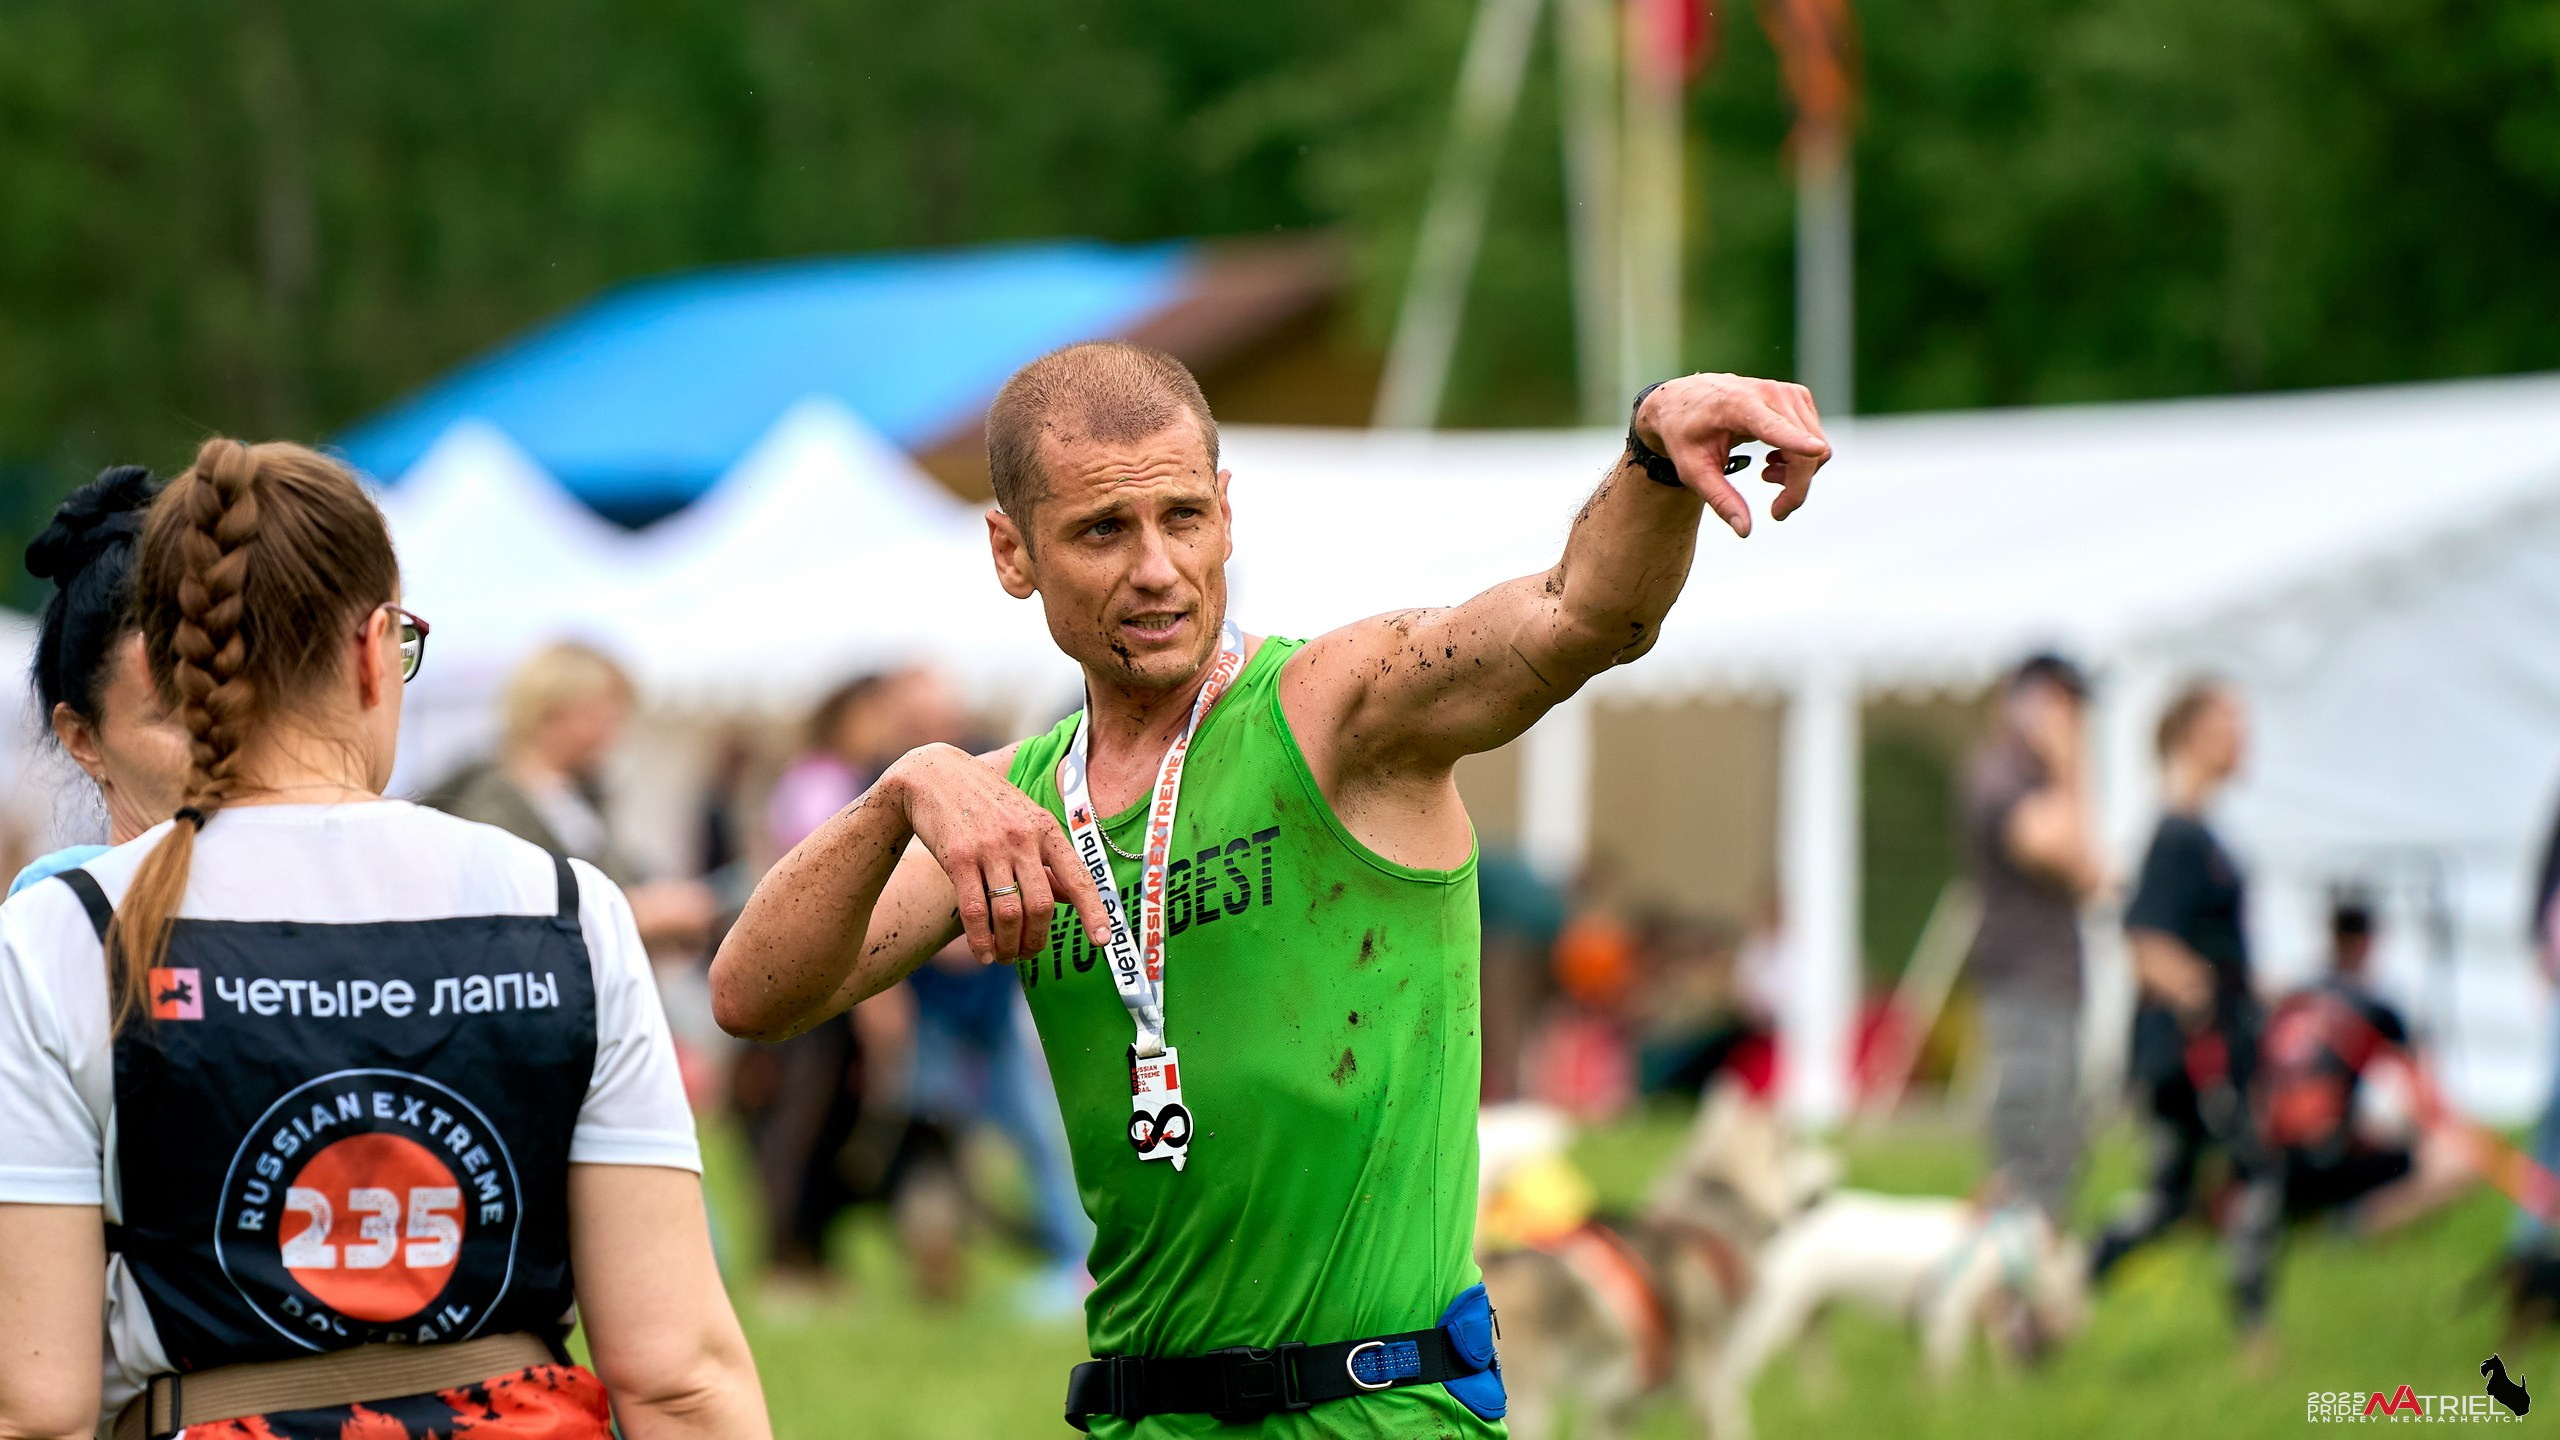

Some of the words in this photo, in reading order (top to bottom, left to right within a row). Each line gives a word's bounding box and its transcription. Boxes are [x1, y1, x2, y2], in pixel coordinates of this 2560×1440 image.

[1149, 755, 1184, 867] EXTREME
[1078, 831, 1111, 893] лапы
[1167, 825, 1281, 938] BEST
[1145, 871, 1163, 981] RUSSIAN
[215, 975, 415, 1018] четыре
[428, 972, 559, 1017] лапы
[1131, 1064, 1158, 1074] RUSSIAN
[1132, 1071, 1161, 1081] EXTREME
[1132, 1080, 1147, 1088] DOG
[1133, 1086, 1152, 1094] TRAIL
[238, 1091, 361, 1232] RUSSIAN
[372, 1091, 504, 1226] EXTREME
[281, 1186, 461, 1270] 235
[364, 1304, 472, 1344] RAIL
